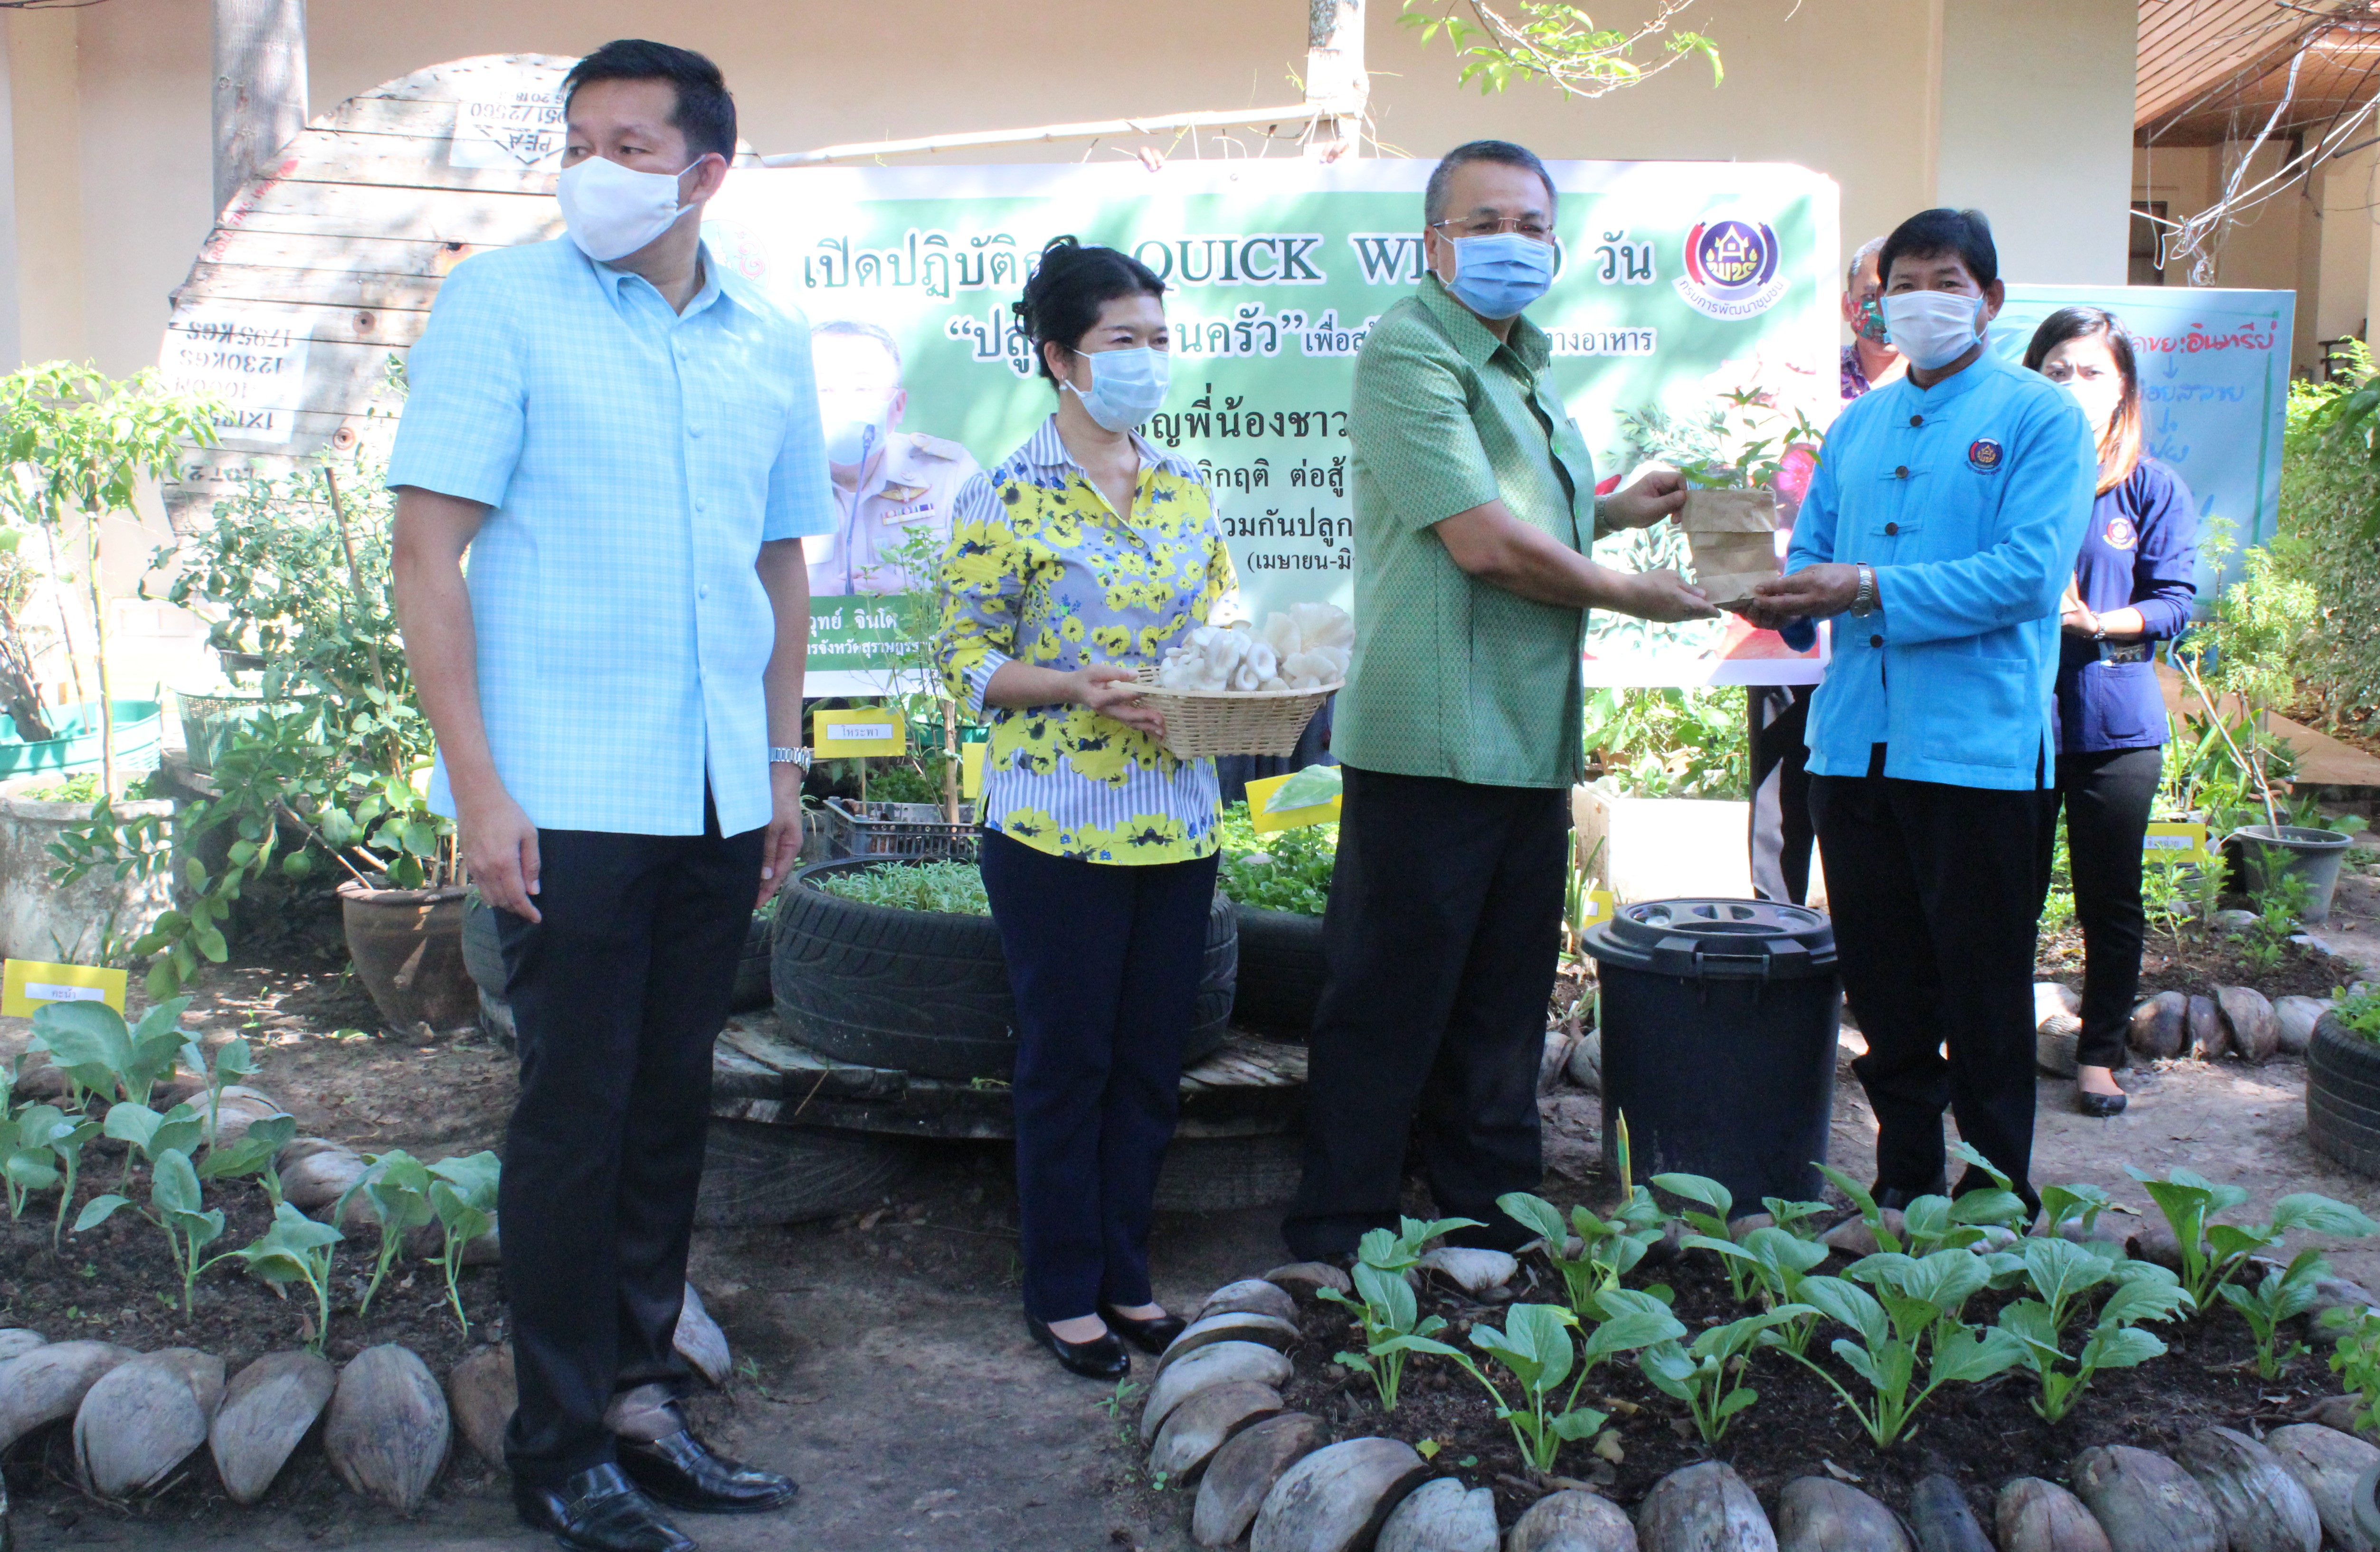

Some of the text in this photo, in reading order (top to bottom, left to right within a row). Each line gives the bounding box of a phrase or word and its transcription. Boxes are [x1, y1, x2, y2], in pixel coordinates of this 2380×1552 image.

[509, 133, 552, 152] PEA
[1134, 237, 1322, 291] QUICK
[1353, 237, 1425, 280] WI
[1594, 230, 1651, 280] วัน
[1679, 280, 1784, 315] กรมการพัฒนาชุมชน
[180, 349, 284, 374] 1230KGS
[1290, 455, 1346, 498] ต่อสู้
[1247, 547, 1355, 572] (เมษายน-มิ
[809, 606, 843, 637] วุทย์
[841, 725, 879, 737] โหระพา
